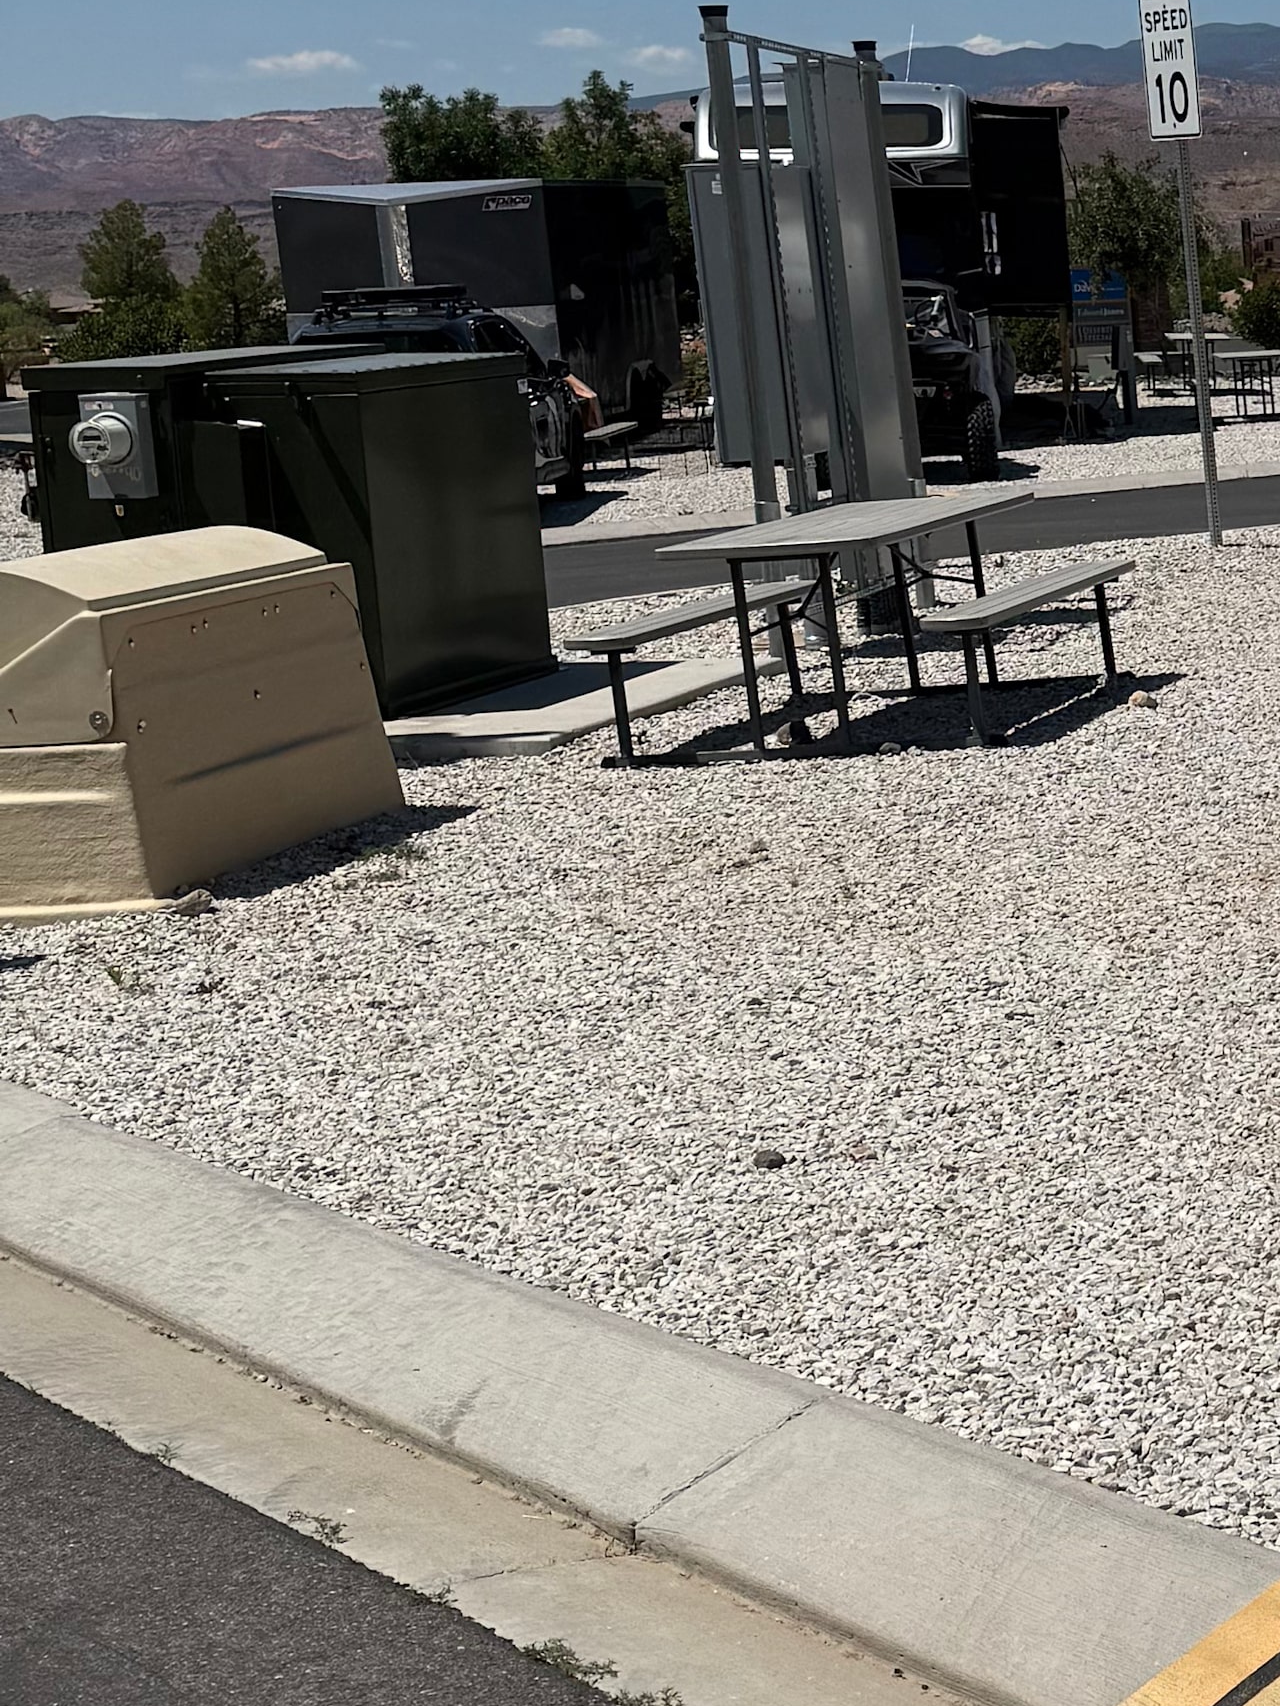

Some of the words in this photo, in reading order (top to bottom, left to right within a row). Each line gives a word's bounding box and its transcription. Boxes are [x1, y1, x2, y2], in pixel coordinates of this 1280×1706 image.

[1144, 8, 1188, 33] SPEED
[1151, 38, 1185, 62] LIMIT
[1155, 71, 1189, 124] 10
